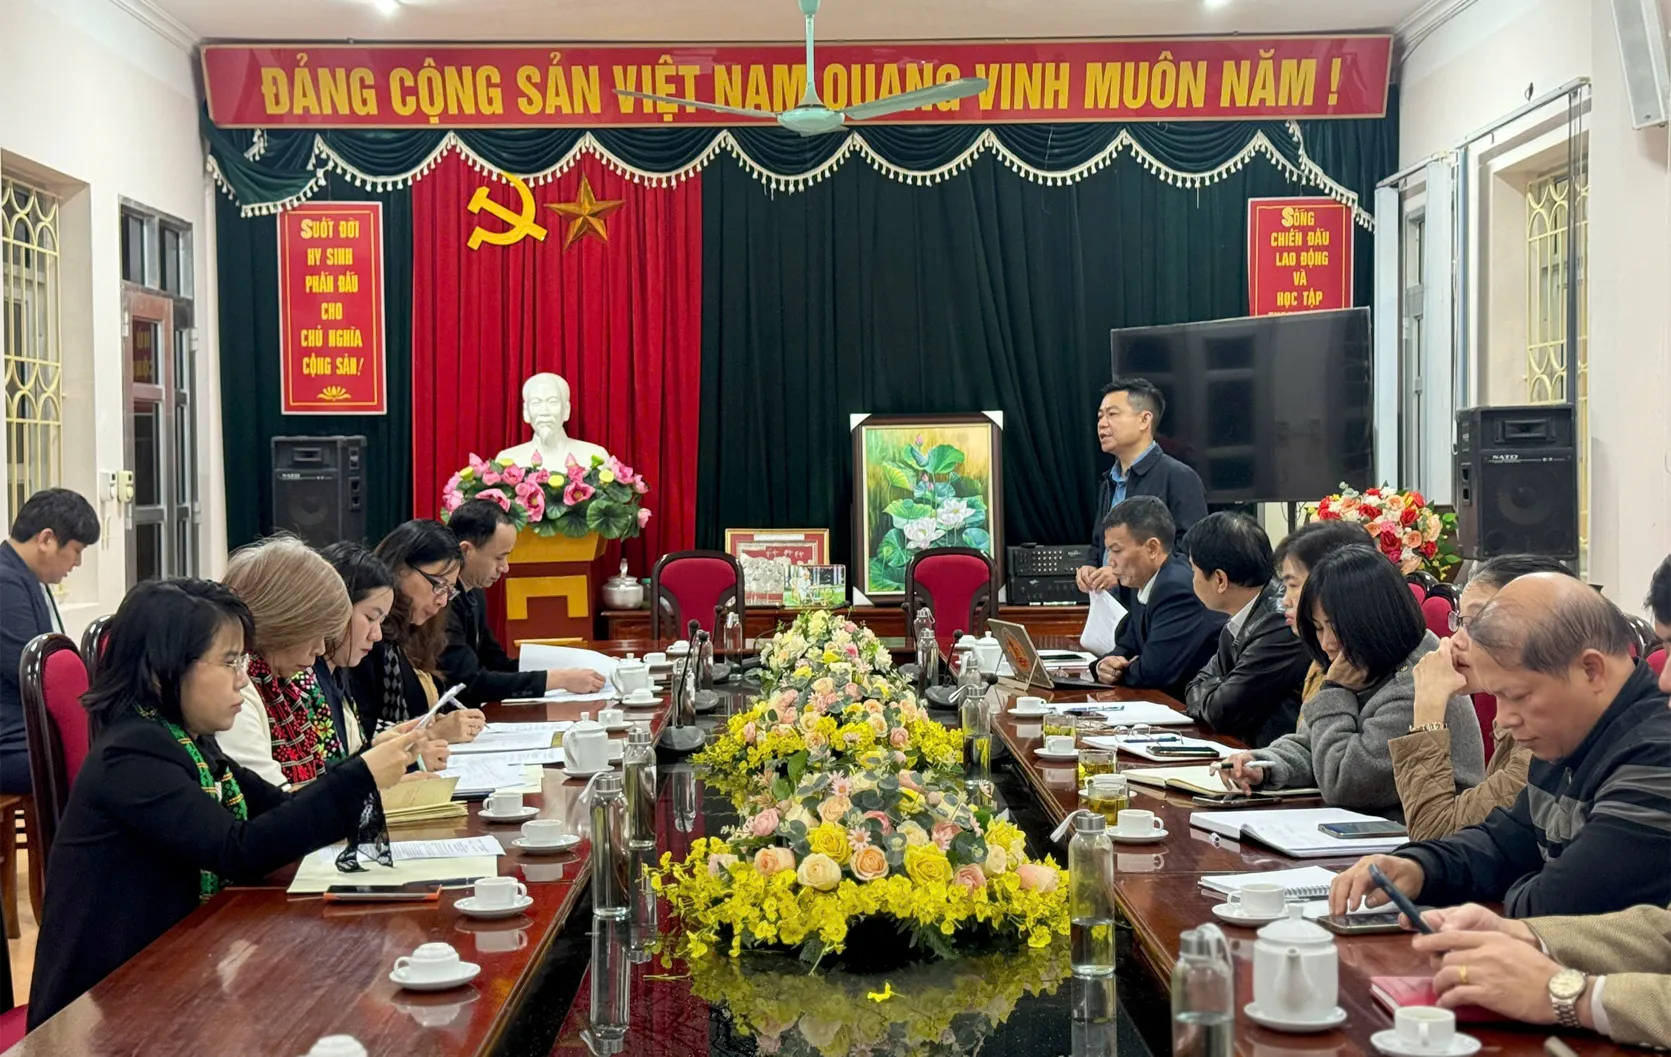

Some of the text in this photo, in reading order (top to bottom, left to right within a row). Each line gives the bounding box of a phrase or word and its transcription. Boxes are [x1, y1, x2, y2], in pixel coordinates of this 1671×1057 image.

[261, 53, 378, 115] ĐẢNG
[389, 58, 503, 123] CỘNG
[516, 52, 601, 115] SẢN
[612, 54, 700, 122] VIỆT
[714, 64, 807, 113] NAM
[823, 63, 961, 111] QUANG
[975, 63, 1070, 110] VINH
[1084, 51, 1207, 109] MUÔN
[1220, 49, 1317, 107] NĂM
[1281, 206, 1315, 227] SỐNG
[301, 217, 335, 239] SUỐT
[1270, 227, 1330, 247] CHIẾN ĐẤU
[306, 248, 353, 266] HY SINH
[1275, 248, 1329, 268] LAO ĐỘNG
[337, 270, 359, 293] ĐẤU
[1293, 269, 1308, 287] VÀ
[1276, 288, 1323, 309] HỌC TẬP
[321, 302, 343, 321] CHO
[300, 325, 323, 347] CHỦ
[302, 352, 332, 377] CỘNG
